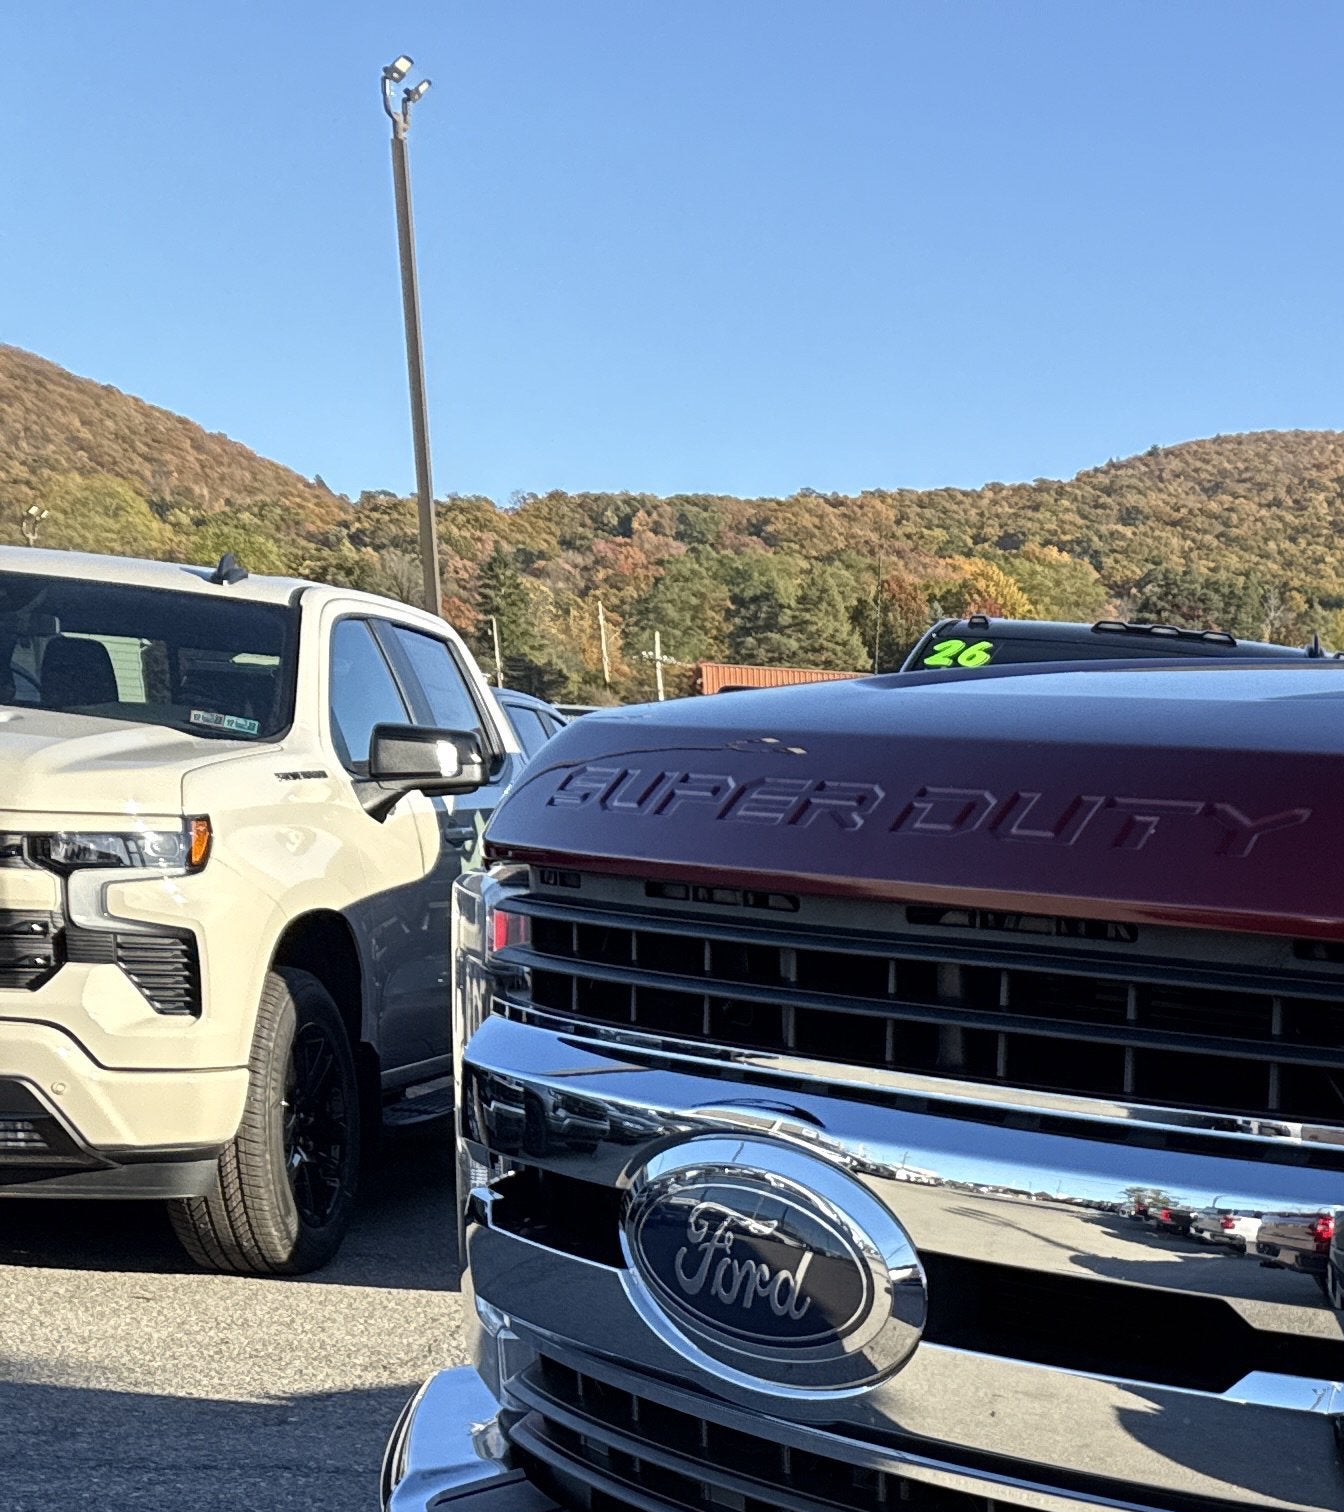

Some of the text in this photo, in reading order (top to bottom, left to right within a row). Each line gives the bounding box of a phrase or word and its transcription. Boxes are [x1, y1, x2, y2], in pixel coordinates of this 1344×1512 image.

[924, 639, 993, 669] 26
[546, 766, 1312, 857] SUPER DUTY
[675, 1201, 813, 1320] Ford
